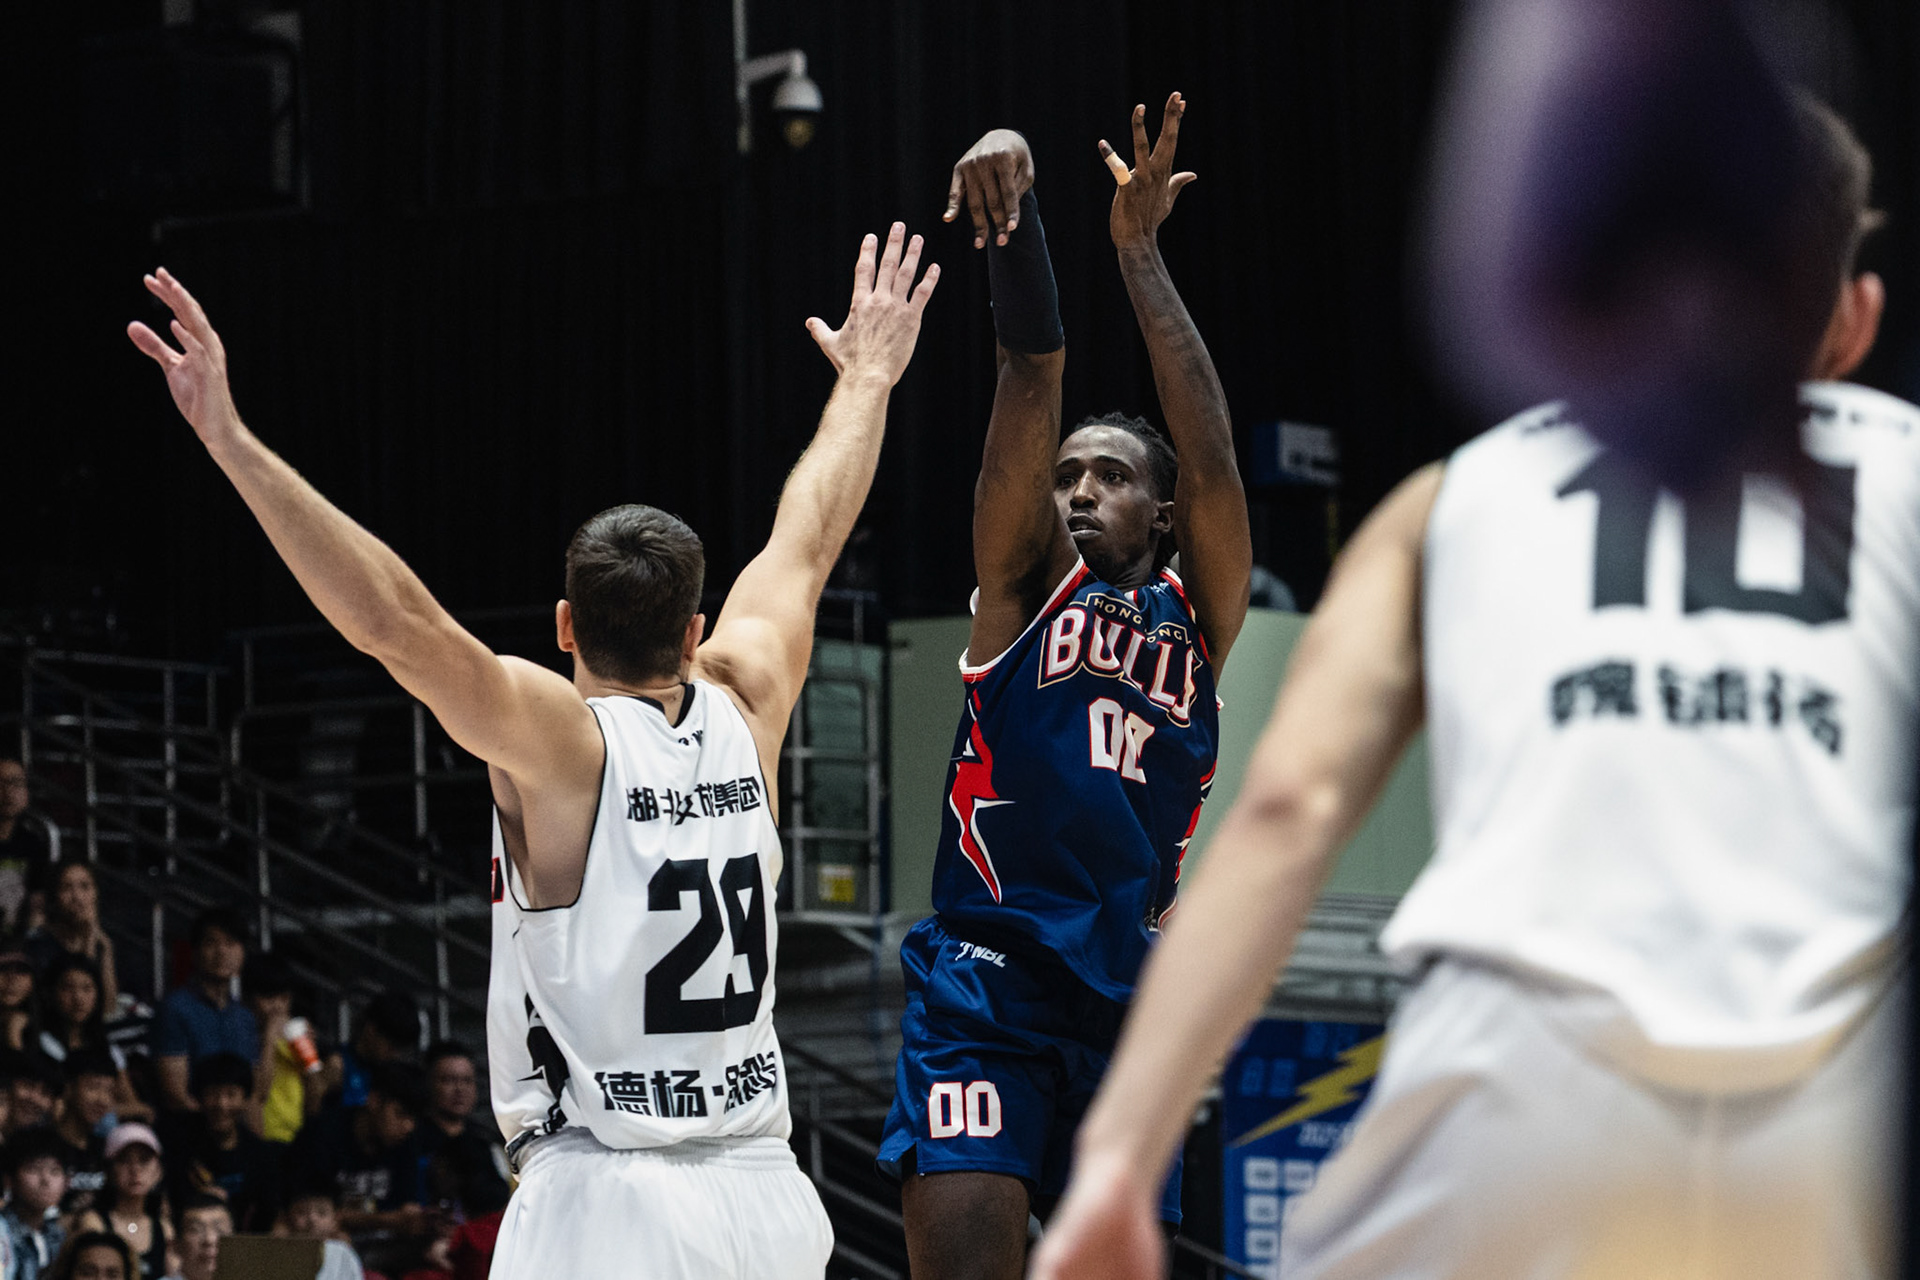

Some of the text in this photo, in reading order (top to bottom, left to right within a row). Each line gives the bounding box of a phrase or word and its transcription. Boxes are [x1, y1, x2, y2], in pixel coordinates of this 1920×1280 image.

[1556, 447, 1857, 626] 10
[1093, 597, 1182, 644] HONG ONG
[928, 1080, 1002, 1139] 00
